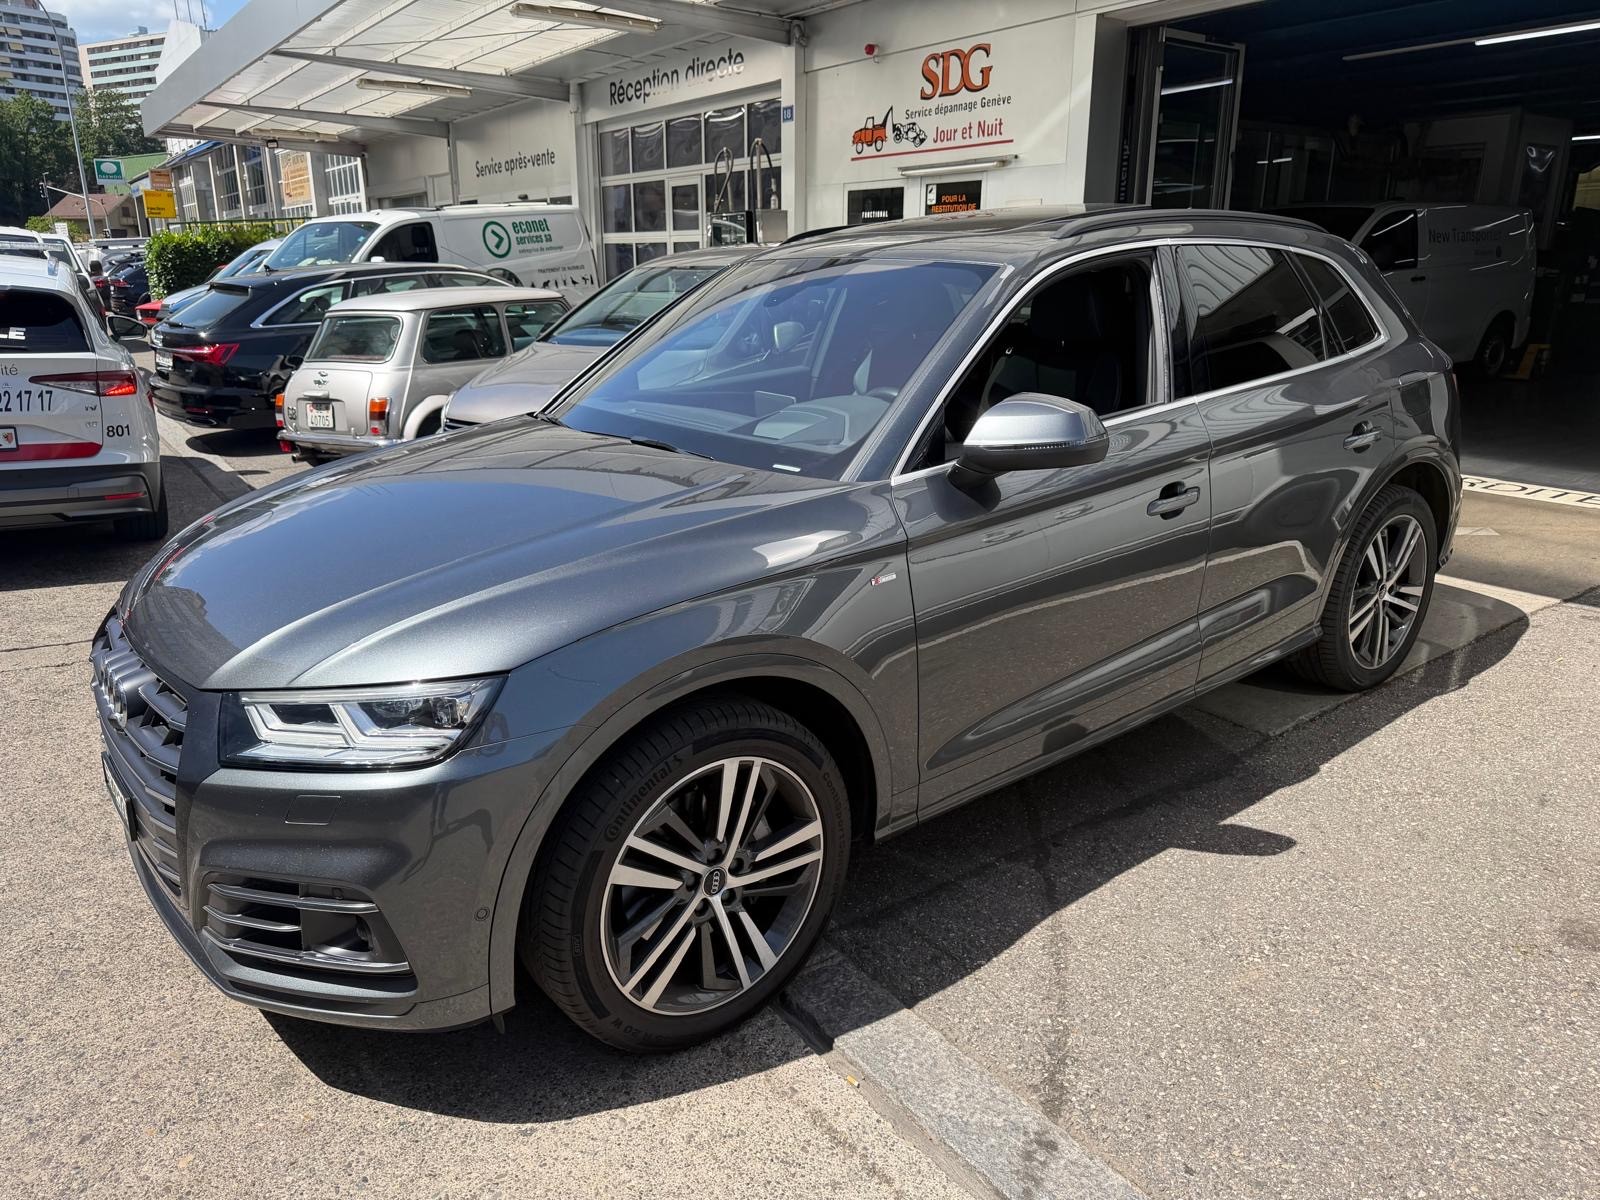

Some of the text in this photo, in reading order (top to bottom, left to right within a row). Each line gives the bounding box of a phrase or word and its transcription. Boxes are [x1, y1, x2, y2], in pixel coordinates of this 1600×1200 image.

[610, 47, 745, 106] Réception directe
[920, 43, 993, 100] SDG
[783, 108, 791, 119] 18
[905, 94, 1012, 120] Service dépannage Genève
[933, 118, 1004, 143] Jour et Nuit
[475, 156, 502, 178] Service
[942, 194, 967, 203] POUR LA
[511, 218, 551, 235] econet
[516, 233, 552, 246] services sa
[1428, 229, 1450, 244] New
[16, 390, 32, 412] 17
[38, 390, 53, 412] 17
[310, 415, 330, 427] 40705
[106, 424, 131, 438] 801
